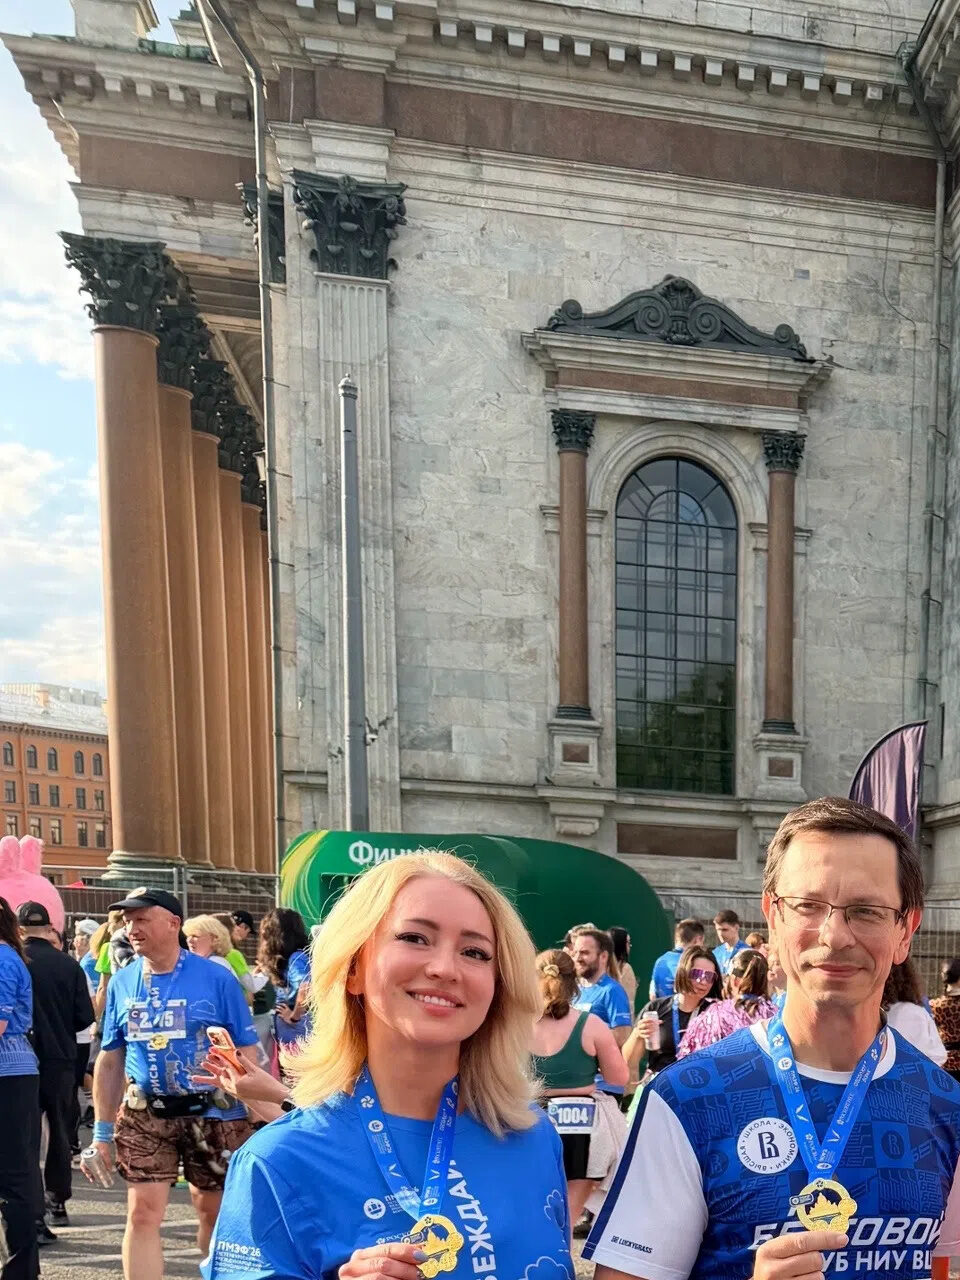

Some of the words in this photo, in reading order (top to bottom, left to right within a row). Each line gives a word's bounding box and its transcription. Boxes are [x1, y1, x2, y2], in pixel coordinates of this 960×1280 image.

[149, 1065, 162, 1095] РИСЬ
[557, 1107, 588, 1124] 1004
[743, 1120, 771, 1138] ШКОЛА
[776, 1123, 796, 1169] ЭКОНОМИКИ
[740, 1145, 767, 1171] ВЫСШАЯ
[855, 1250, 905, 1271] НИУ
